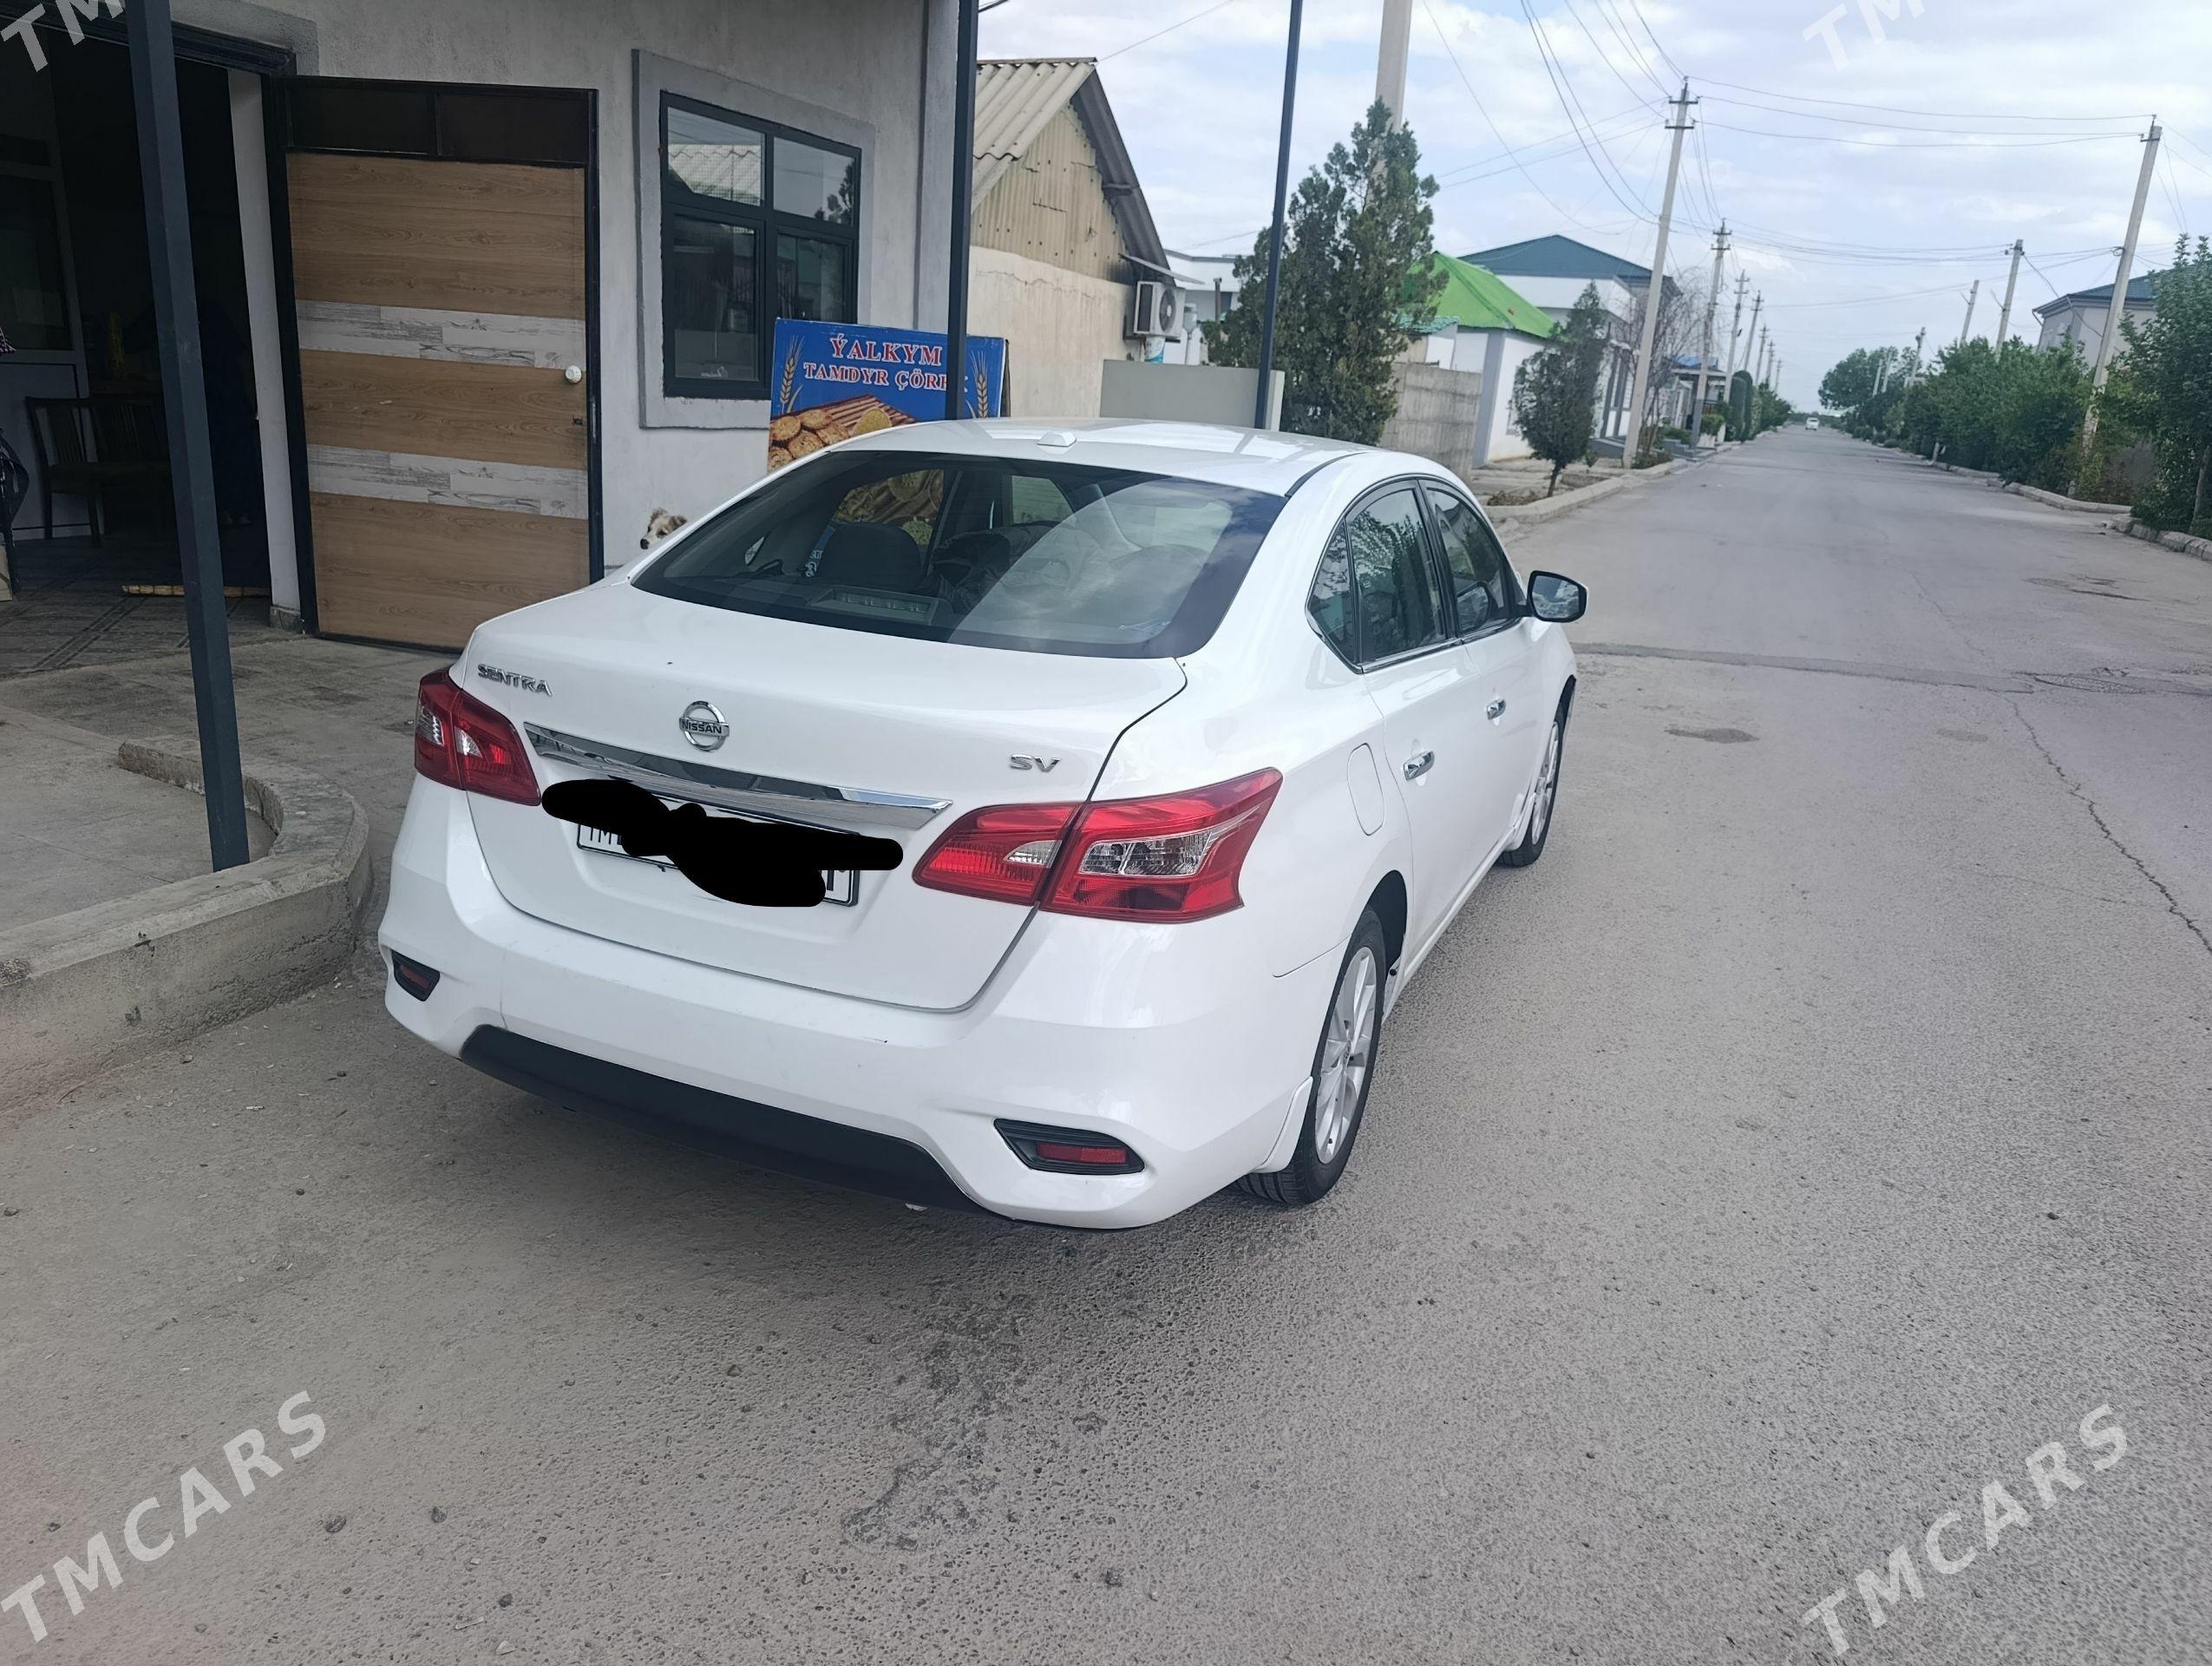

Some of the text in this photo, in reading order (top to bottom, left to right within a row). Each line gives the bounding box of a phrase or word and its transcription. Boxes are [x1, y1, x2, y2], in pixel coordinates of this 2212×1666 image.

[830, 333, 943, 366] ÝALKYM
[803, 362, 890, 386] TAMDYR
[477, 664, 553, 697] SENTRA
[682, 719, 722, 734] NISSAN
[1010, 754, 1062, 773] SV
